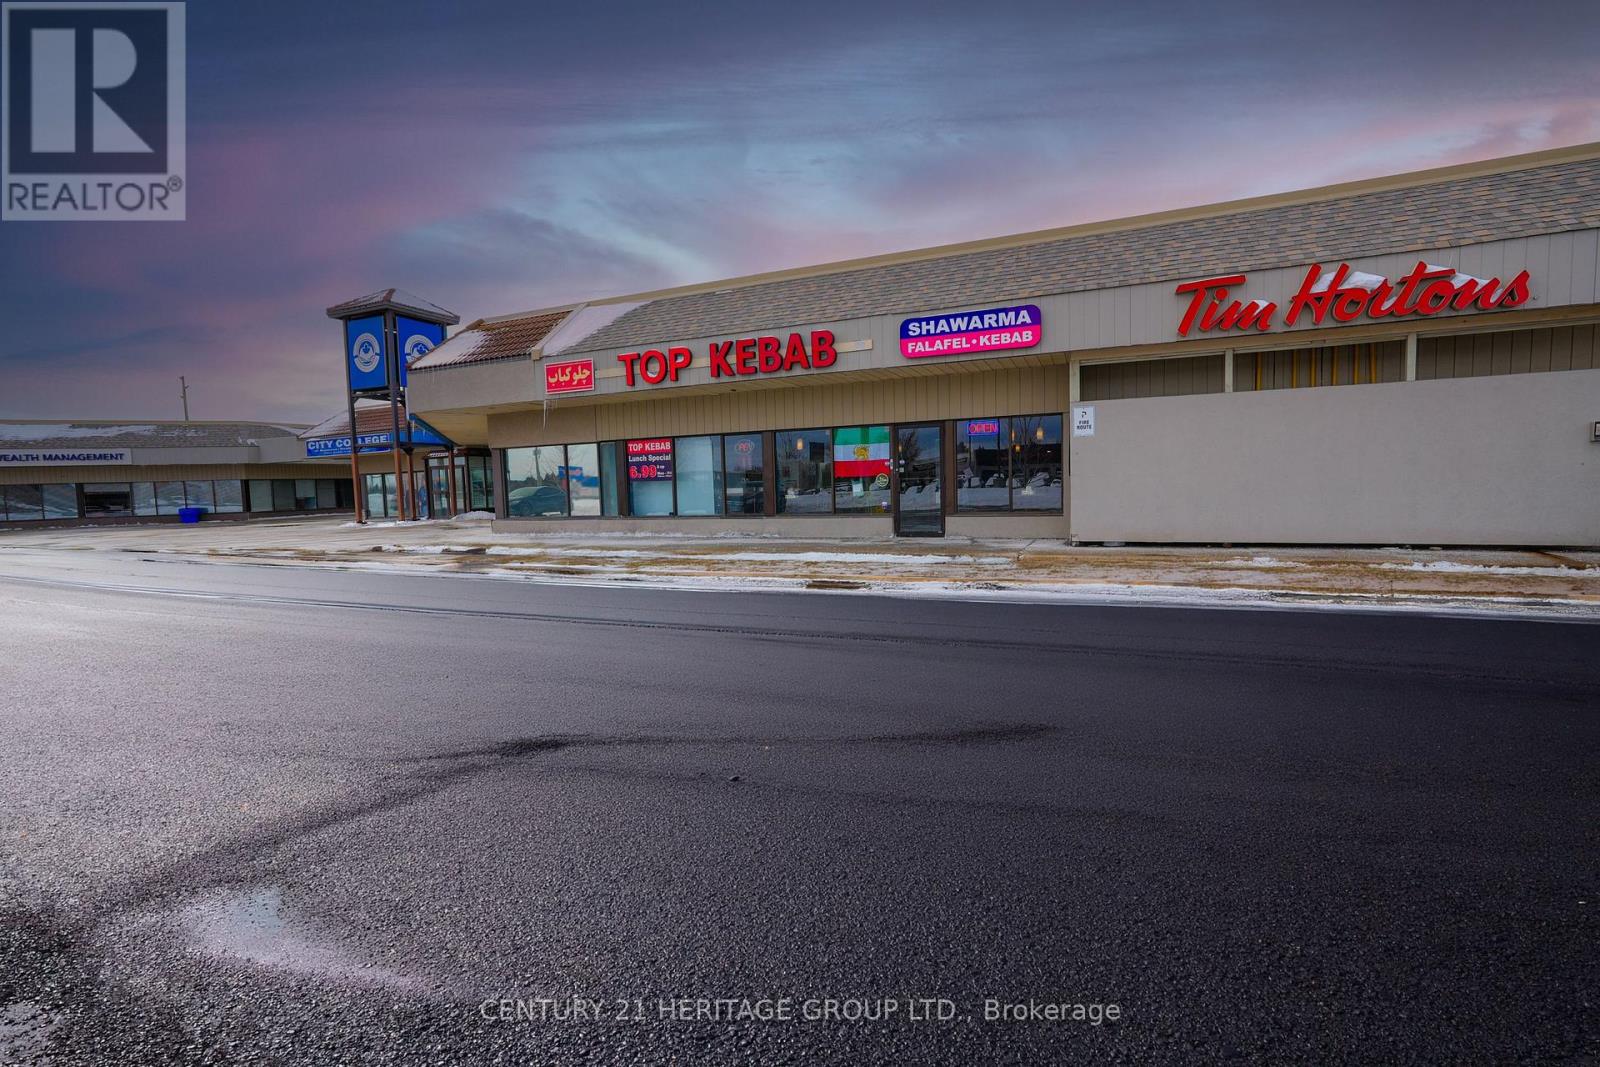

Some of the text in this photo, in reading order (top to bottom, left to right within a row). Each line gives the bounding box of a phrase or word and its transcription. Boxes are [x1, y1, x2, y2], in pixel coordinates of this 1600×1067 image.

[1175, 260, 1531, 337] Tim Hortons
[907, 309, 1032, 336] SHAWARMA
[907, 330, 1033, 354] FALAFEL KEBAB
[617, 329, 838, 387] TOP KEBAB
[968, 423, 997, 434] OPEN
[308, 435, 388, 450] CITY COLEGE
[628, 442, 671, 452] TOP KEBAB
[43, 453, 125, 462] MANAGEMENT
[648, 454, 671, 462] Special
